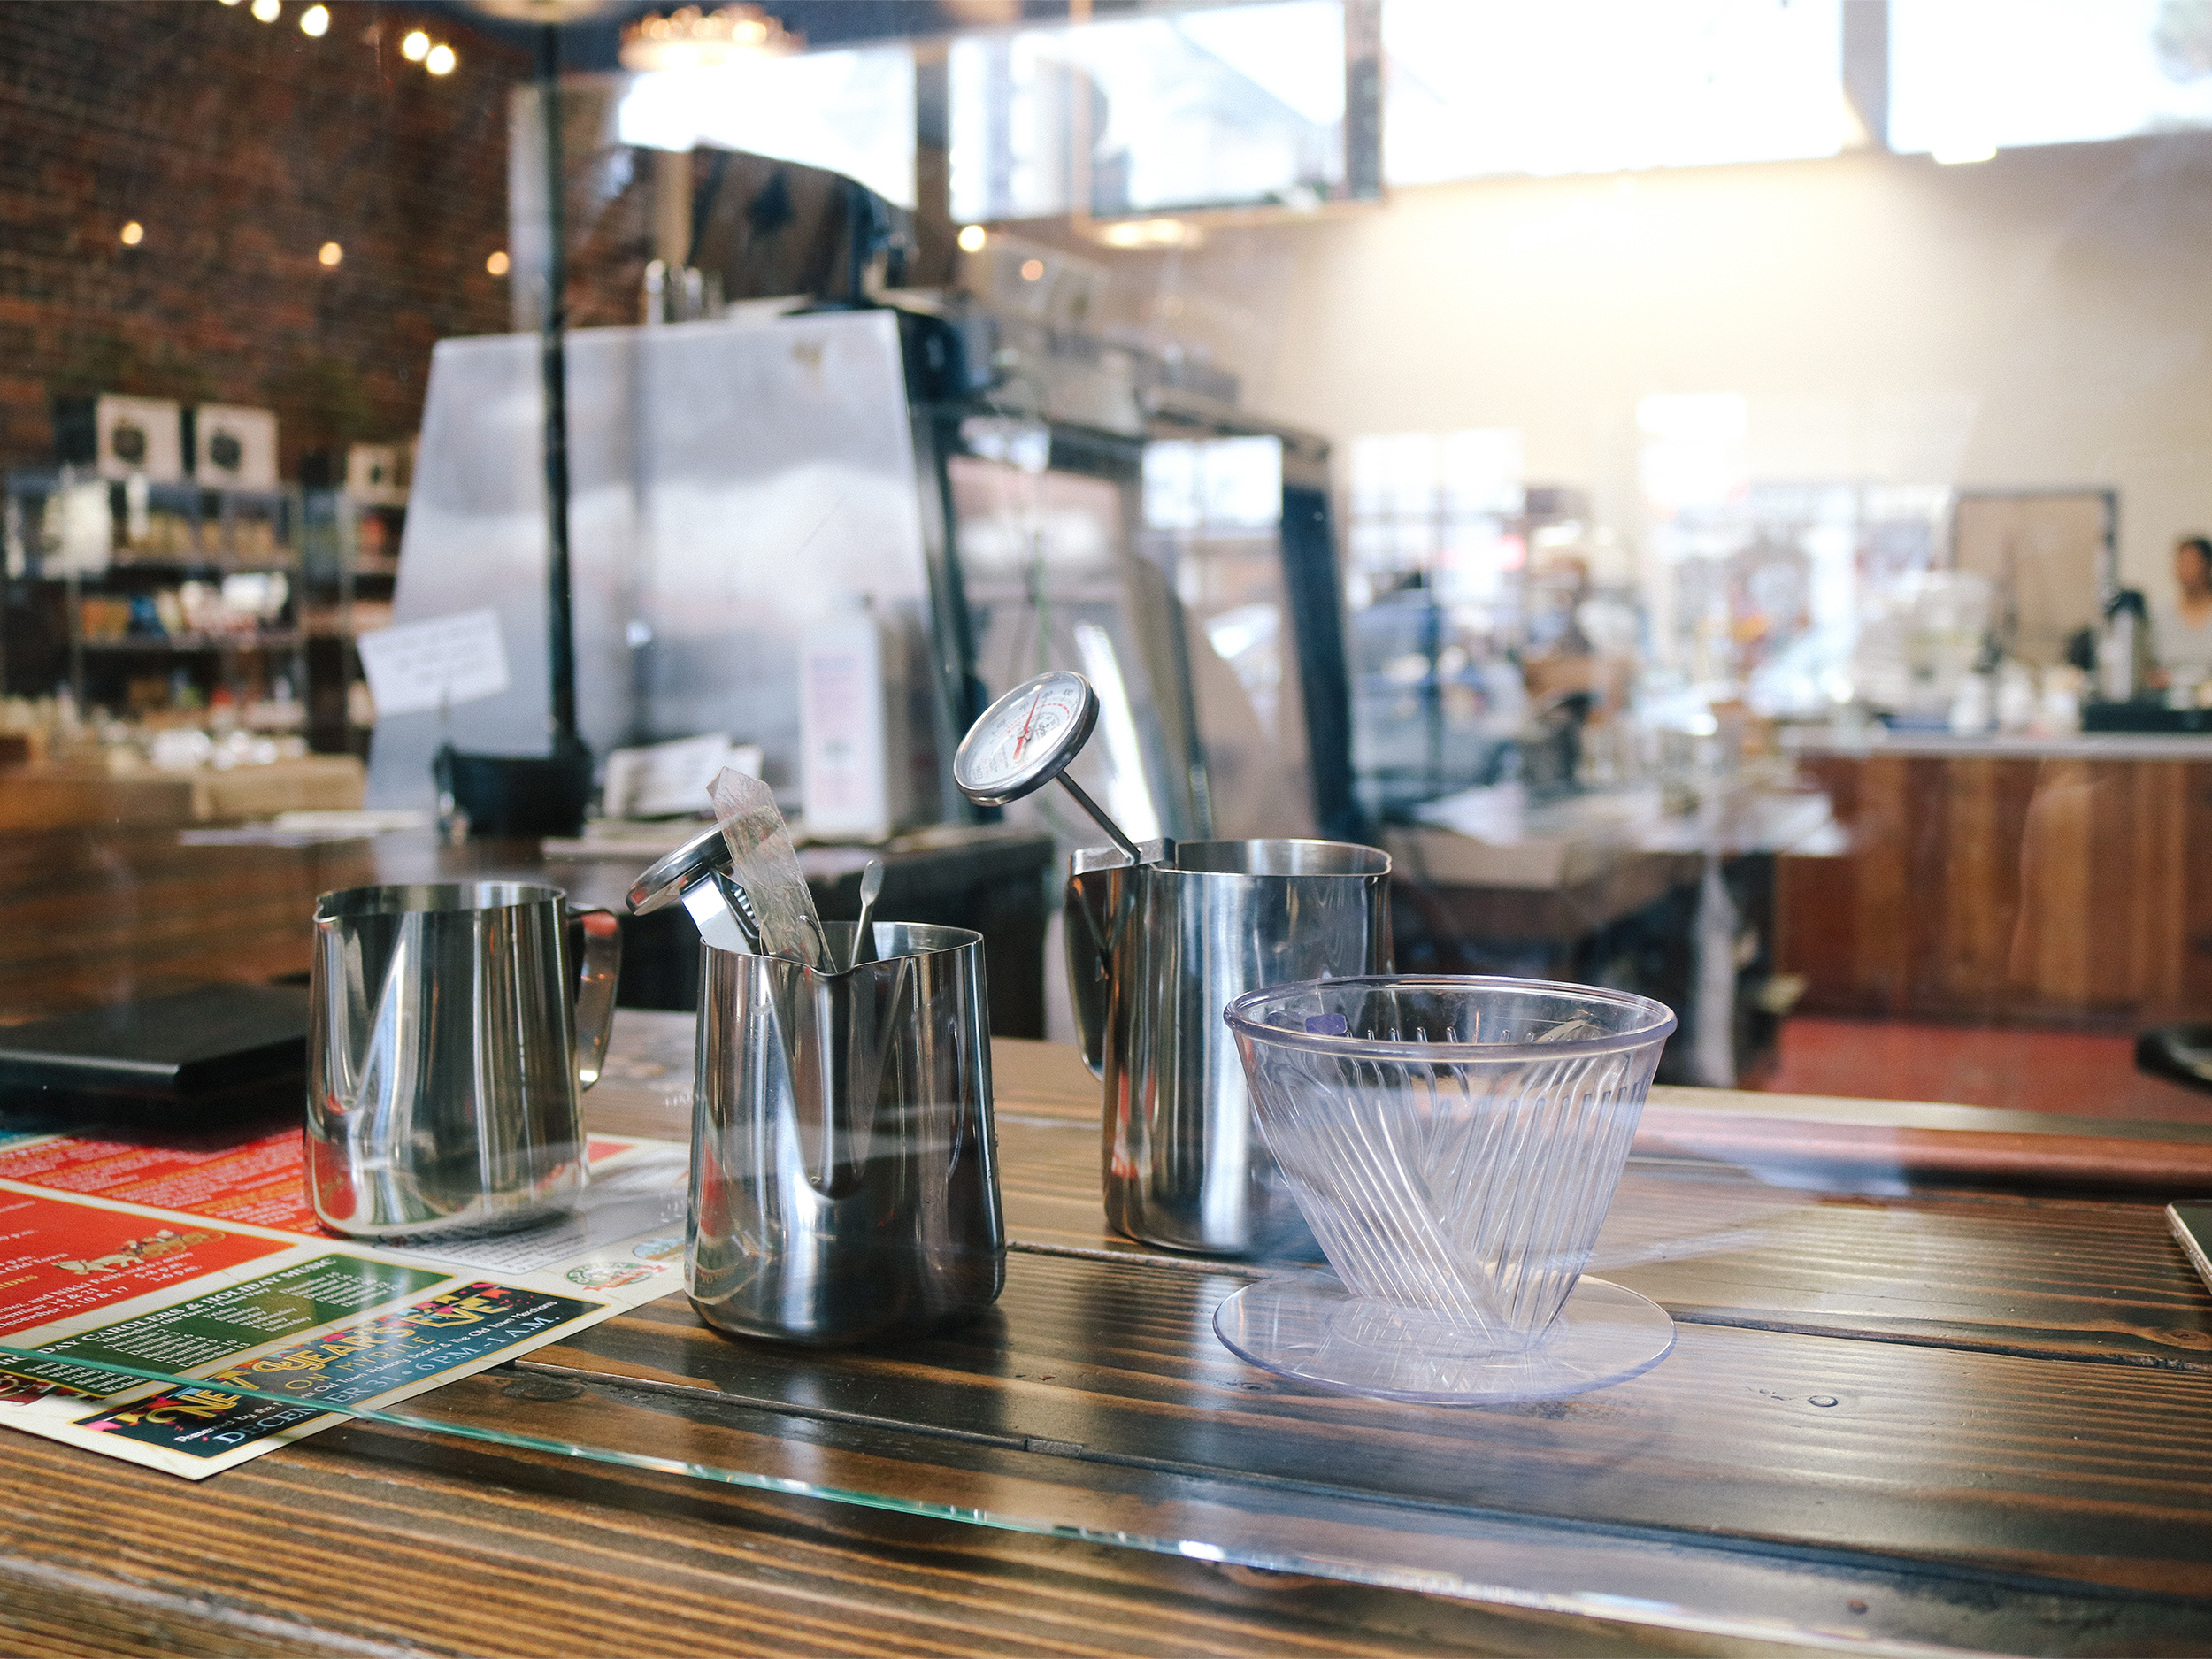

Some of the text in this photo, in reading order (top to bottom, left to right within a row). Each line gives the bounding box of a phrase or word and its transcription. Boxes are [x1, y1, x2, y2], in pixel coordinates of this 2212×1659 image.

[28, 1294, 55, 1303] and
[81, 1308, 185, 1340] CAROLERS
[201, 1276, 281, 1304] HOLIDAY
[279, 1258, 336, 1279] MUSIC
[96, 1323, 162, 1342] Throughout
[180, 1308, 211, 1317] Town
[103, 1332, 159, 1349] December
[114, 1334, 172, 1352] December
[251, 1325, 416, 1372] YEAR'S
[399, 1300, 510, 1328] EVE
[127, 1337, 185, 1356] December
[141, 1340, 197, 1359] December
[153, 1342, 210, 1362] December
[165, 1345, 222, 1364] December
[314, 1382, 339, 1392] Old
[335, 1372, 369, 1383] Town
[365, 1358, 411, 1373] Advisory
[405, 1346, 441, 1359] Board
[468, 1327, 491, 1337] Old
[487, 1318, 515, 1328] Town
[511, 1301, 557, 1318] Merchants
[365, 1376, 402, 1387] 31
[415, 1362, 435, 1371] 6
[505, 1317, 560, 1338] A.M.
[179, 1348, 235, 1367] December
[284, 1336, 436, 1390] ON MYRTLE
[88, 1375, 133, 1389] Sunday
